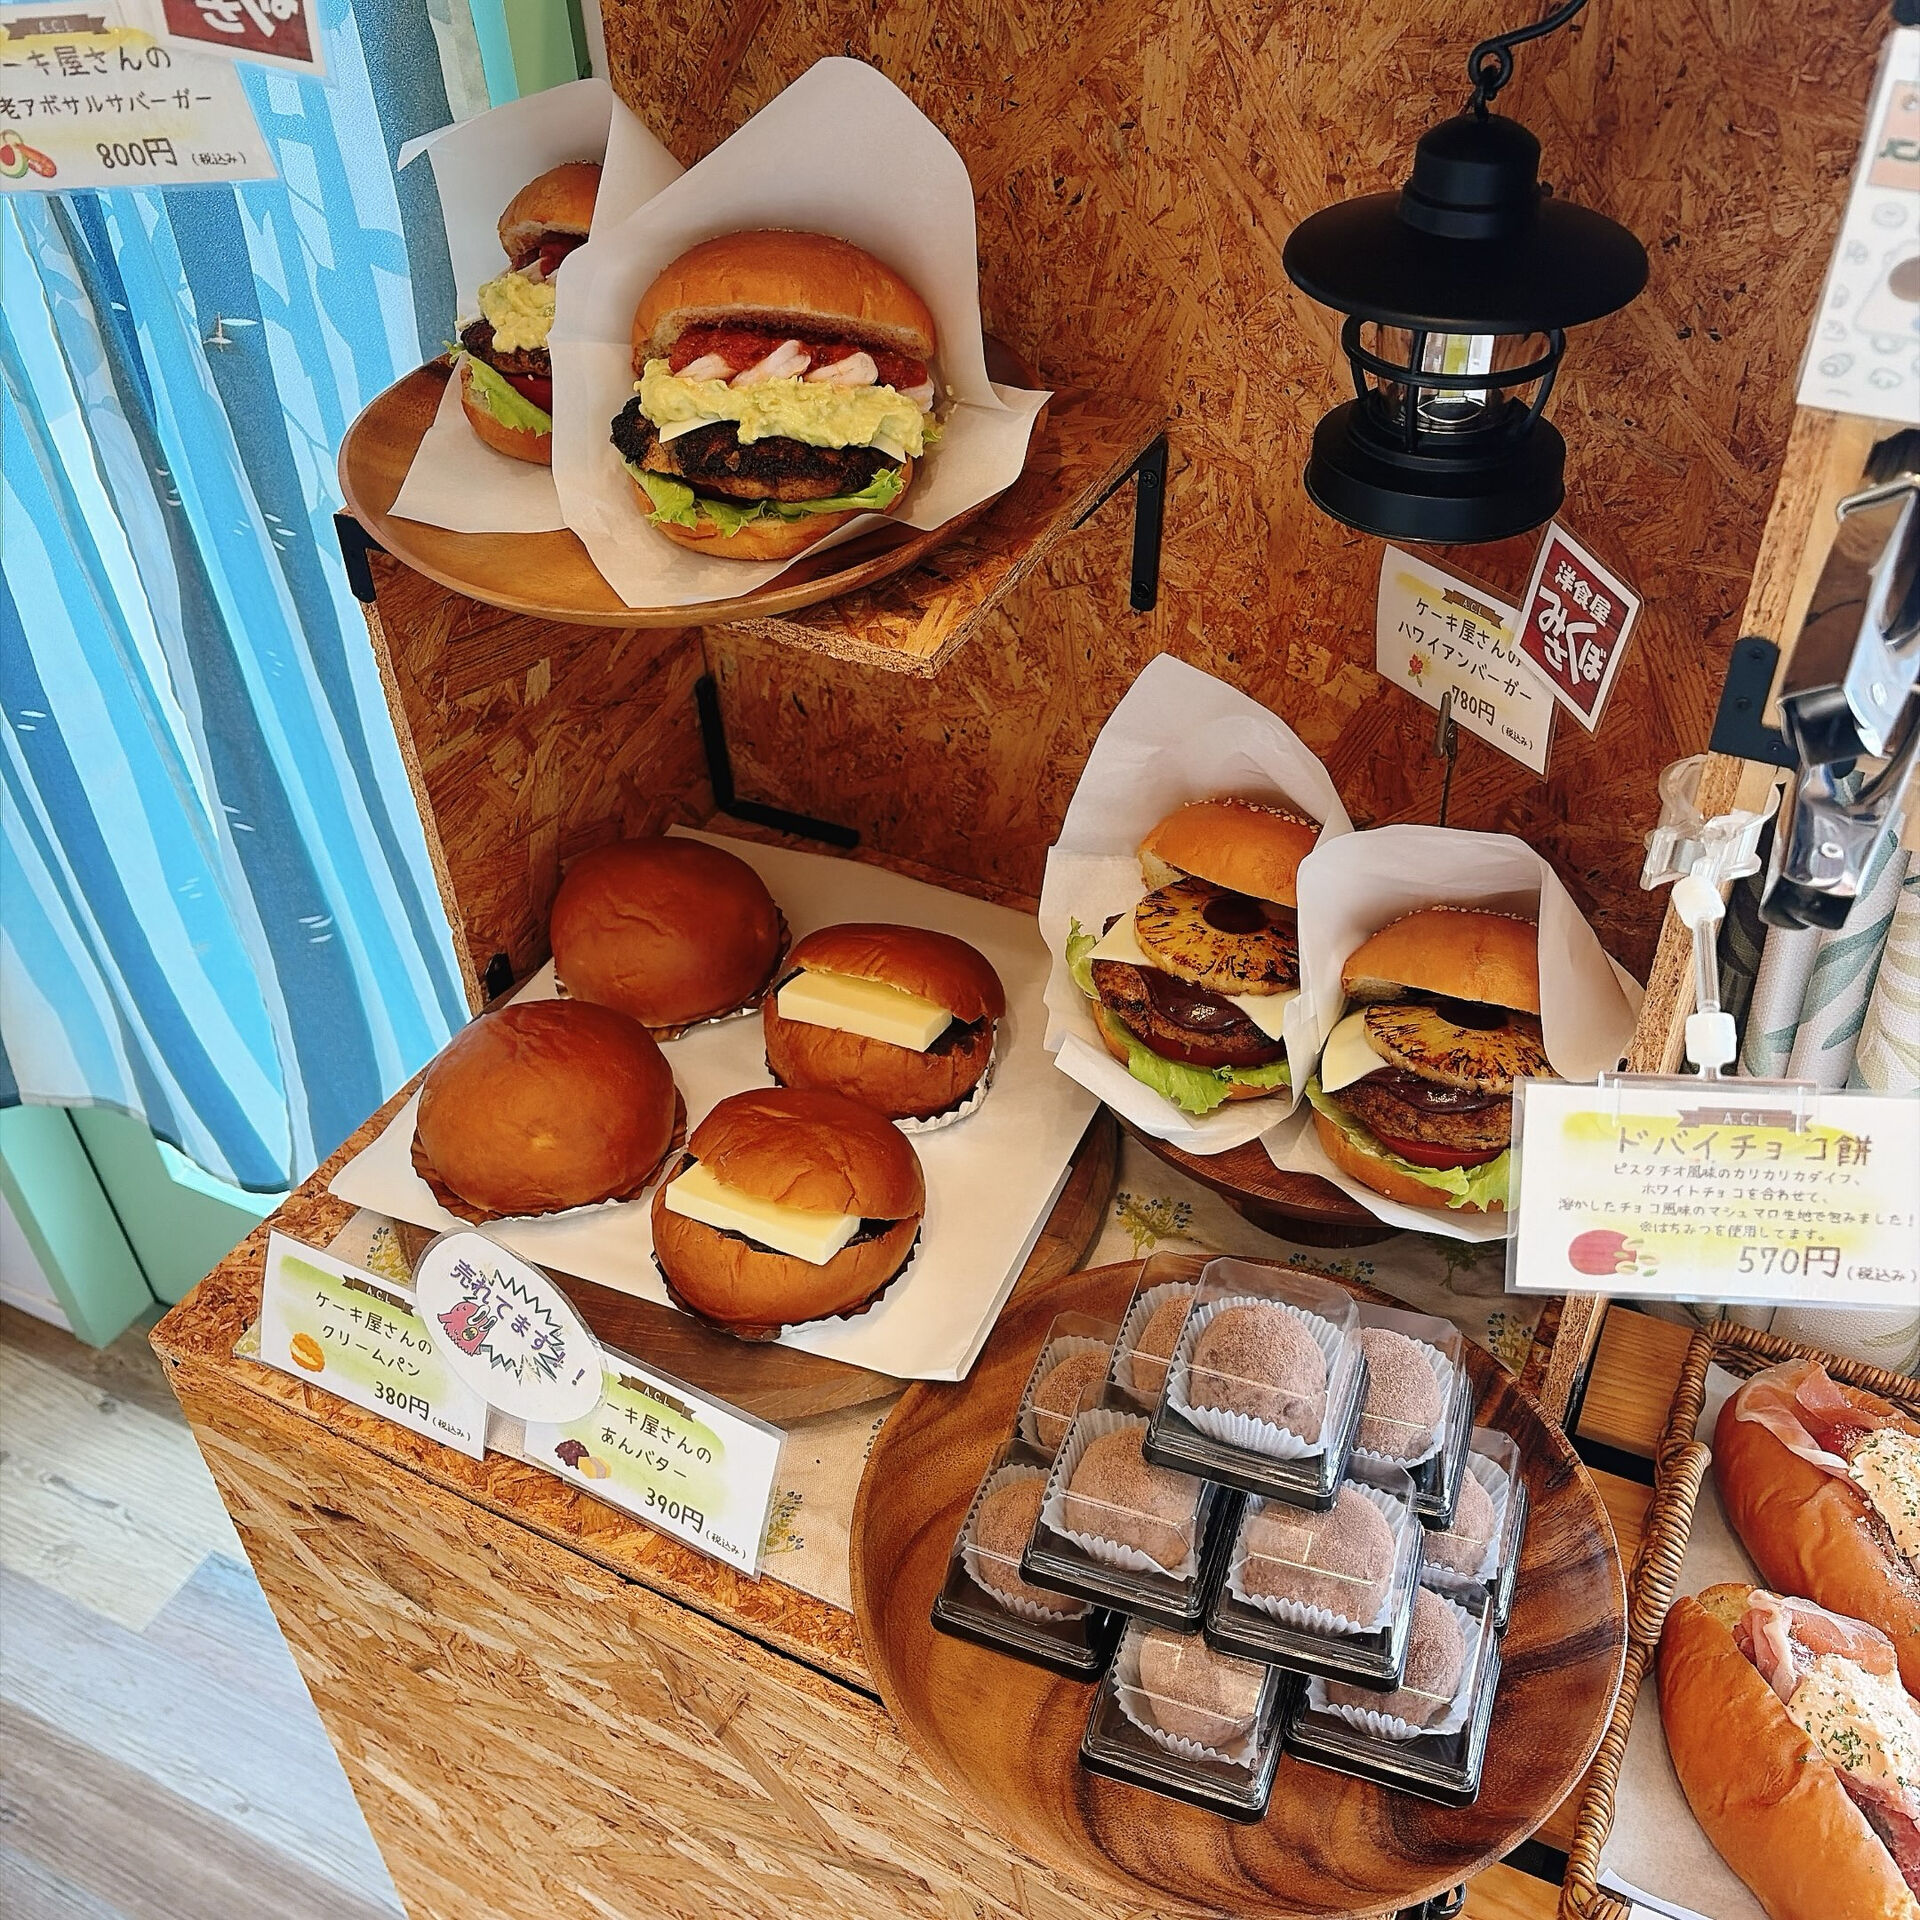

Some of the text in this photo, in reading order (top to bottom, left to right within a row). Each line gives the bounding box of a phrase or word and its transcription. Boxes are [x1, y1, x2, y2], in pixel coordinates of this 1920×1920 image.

[96, 137, 248, 169] 800円 (税込み)
[1554, 560, 1613, 627] 洋食屋
[1398, 621, 1532, 700] ハワイアンバーガー
[1416, 597, 1521, 668] ケーキ屋さんの
[1451, 684, 1534, 750] 780円 (税込み)
[1613, 1162, 1860, 1186] ピスタチオ風味のカリカリカダイフ、
[1619, 1126, 1872, 1167] ドバイチョコ餅
[1641, 1183, 1829, 1204] ホワイトチョコを合わせて、
[1737, 1245, 1917, 1283] 570円 (税込み)
[315, 1291, 432, 1356] ケーキ屋さんの
[322, 1325, 421, 1376] クリームパン
[374, 1380, 471, 1442] 380円 (税込み)
[643, 1386, 670, 1407] A.C.L
[601, 1426, 687, 1479] あんバター
[604, 1400, 713, 1465] ーキ屋さんの
[644, 1486, 747, 1560] 390円 (税込み)
